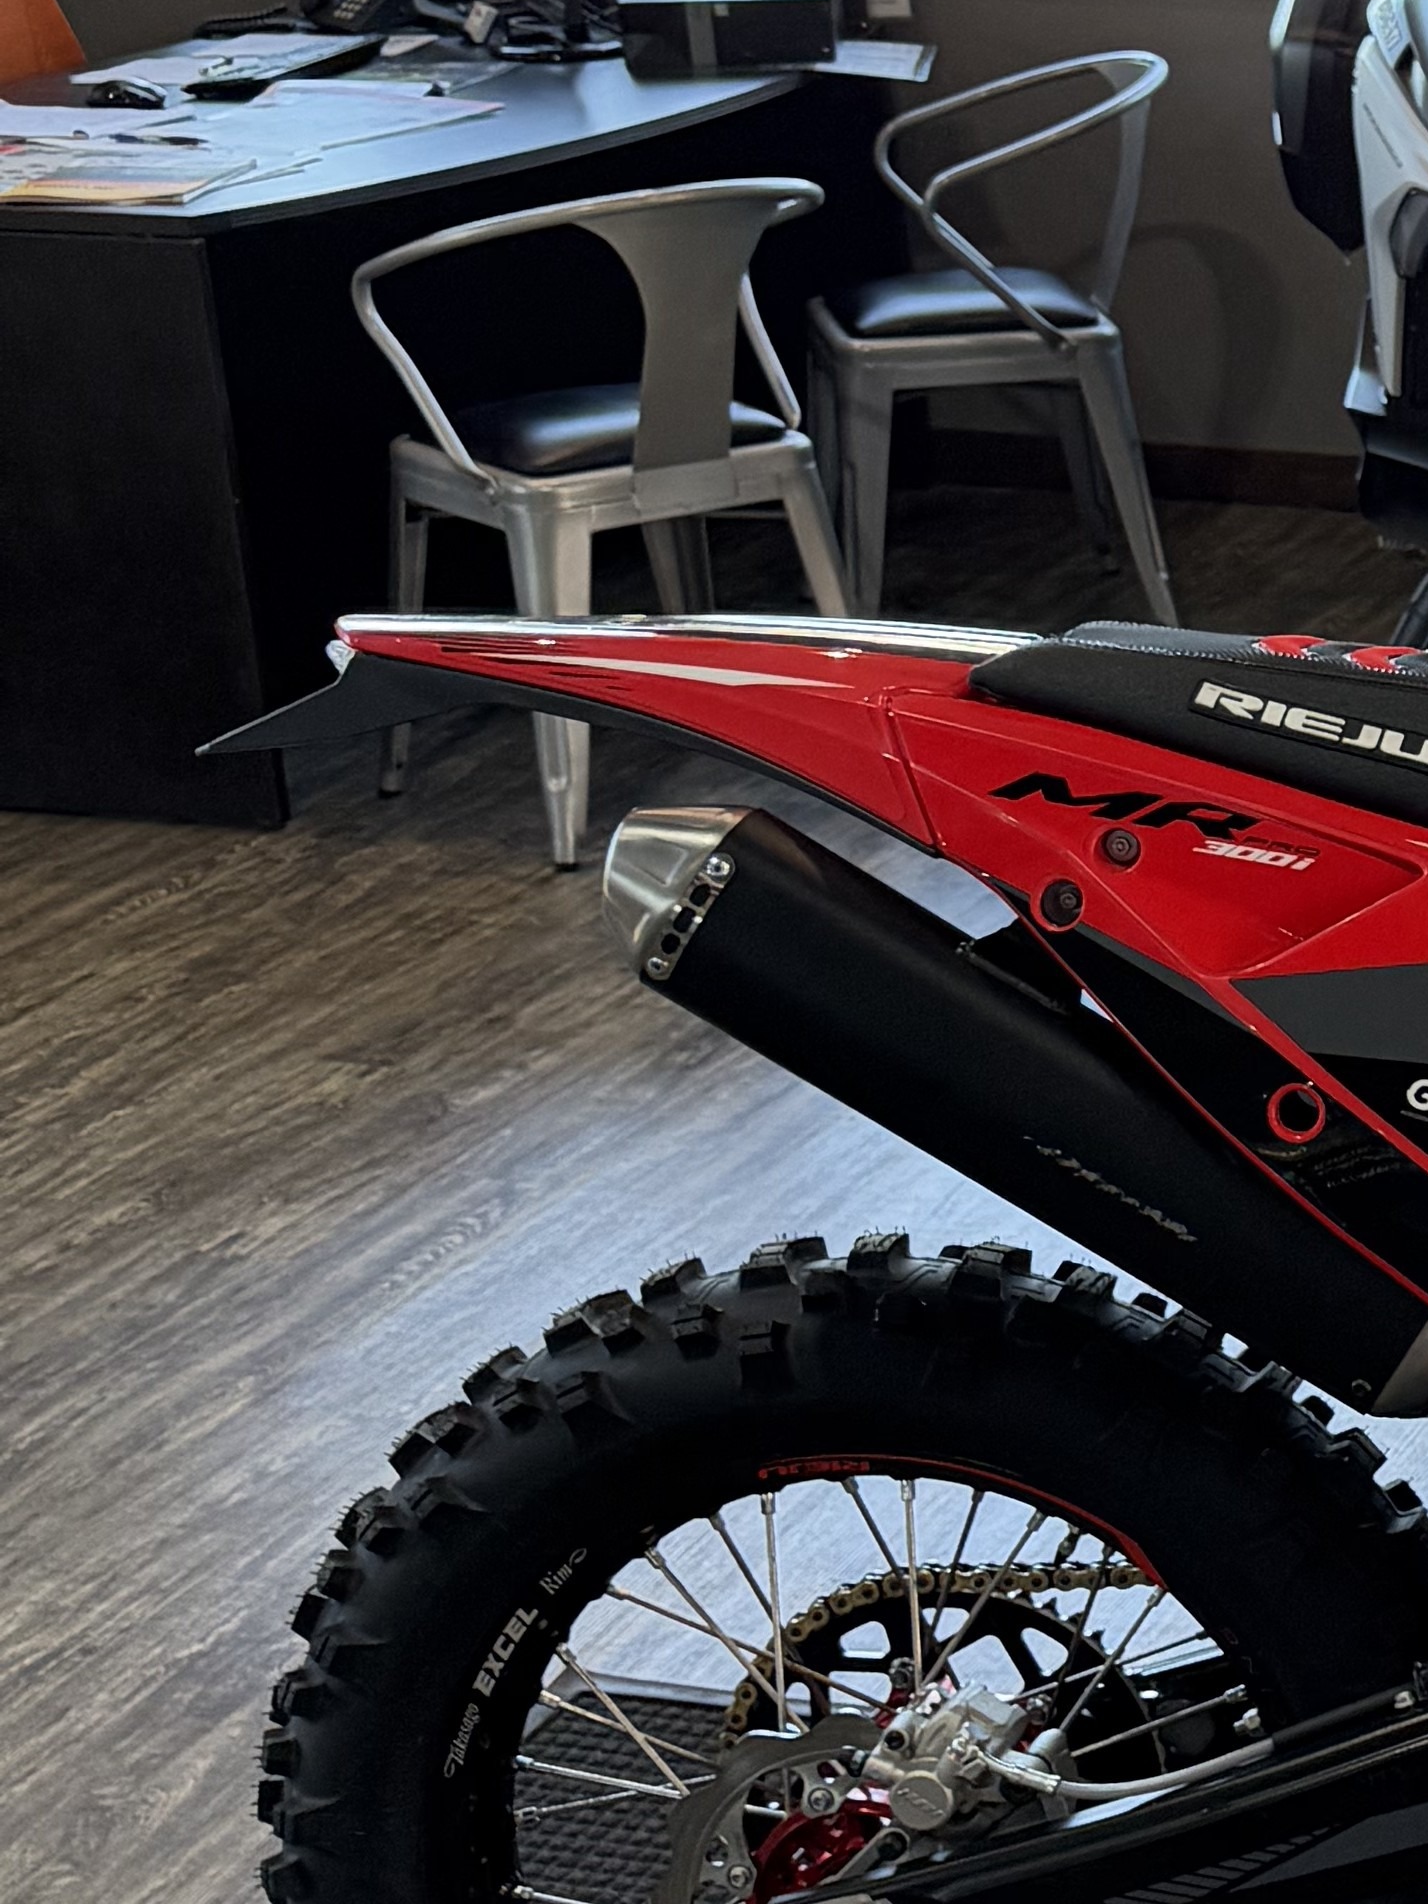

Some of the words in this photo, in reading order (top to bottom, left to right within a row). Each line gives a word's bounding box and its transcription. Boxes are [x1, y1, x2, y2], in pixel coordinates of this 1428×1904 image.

[988, 771, 1261, 841] MR
[1192, 839, 1316, 871] 300i
[471, 1607, 540, 1698] EXCEL
[539, 1553, 582, 1596] Rim
